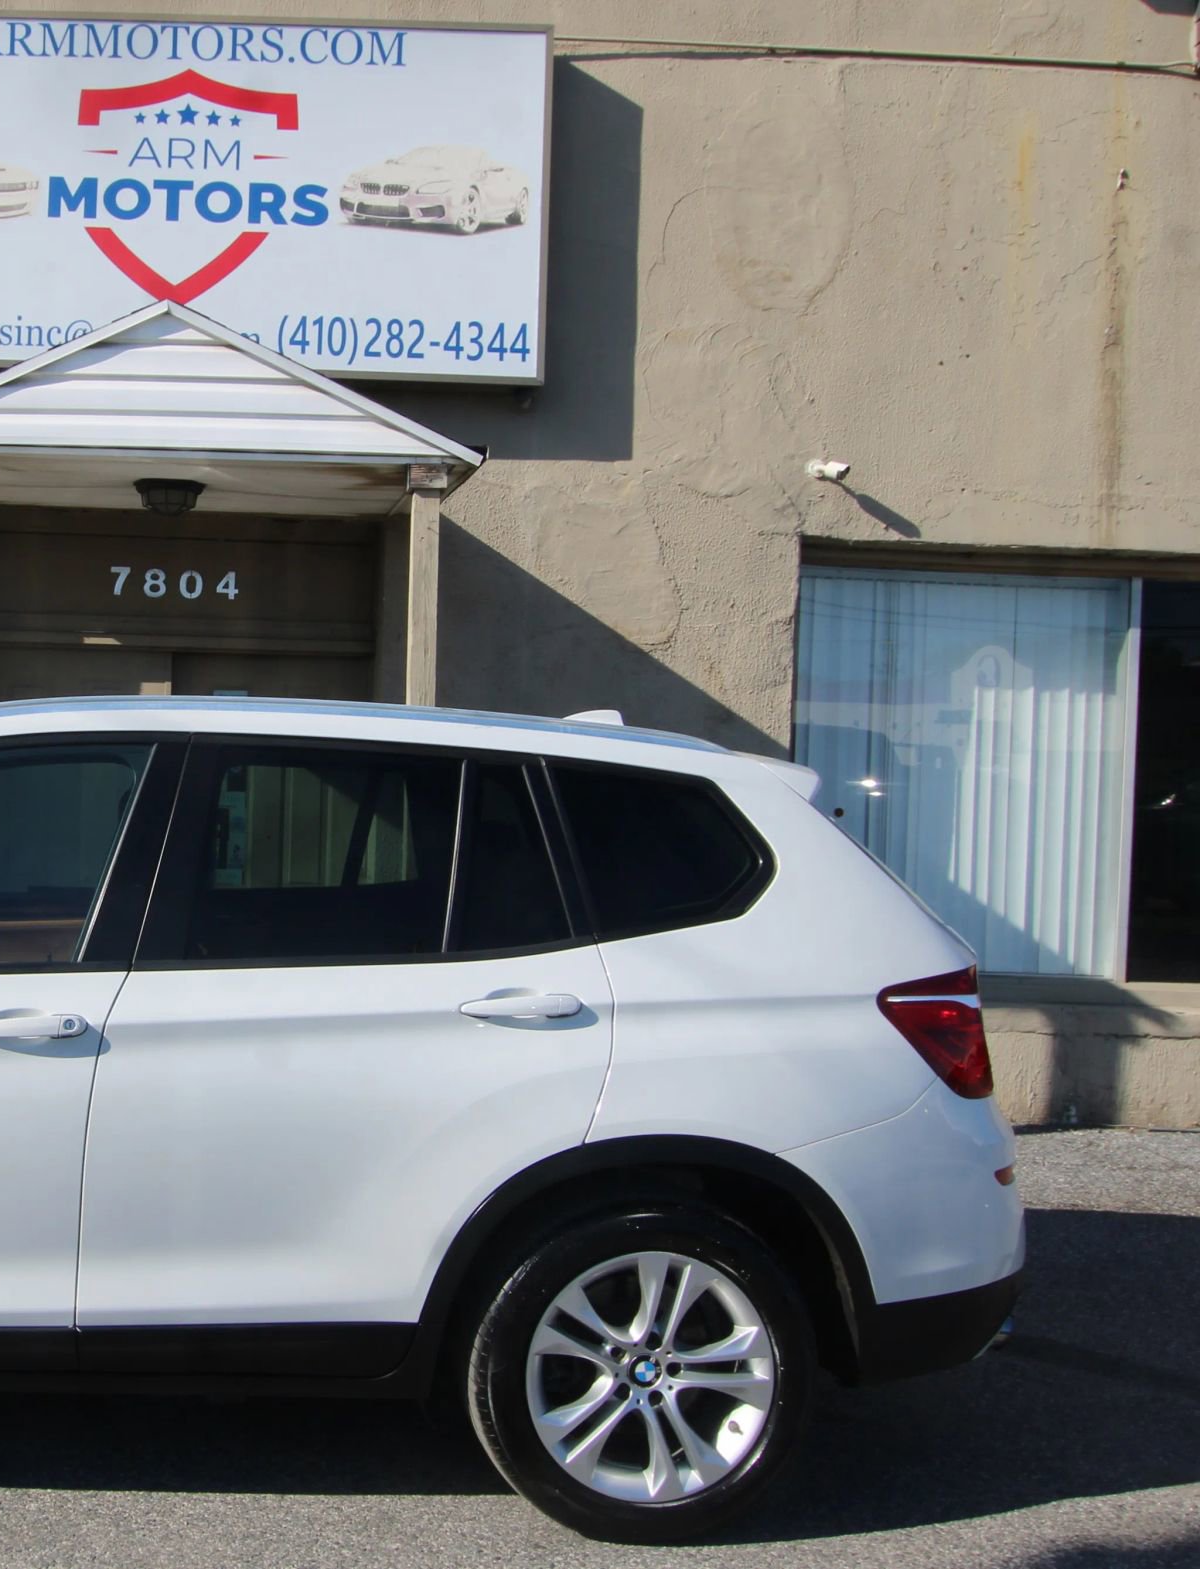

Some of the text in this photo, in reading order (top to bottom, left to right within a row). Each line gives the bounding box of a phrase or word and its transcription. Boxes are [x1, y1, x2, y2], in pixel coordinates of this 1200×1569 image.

[128, 136, 242, 171] ARM
[47, 175, 330, 227] MOTORS
[277, 314, 531, 365] (410)282-4344
[110, 565, 239, 600] 7804
